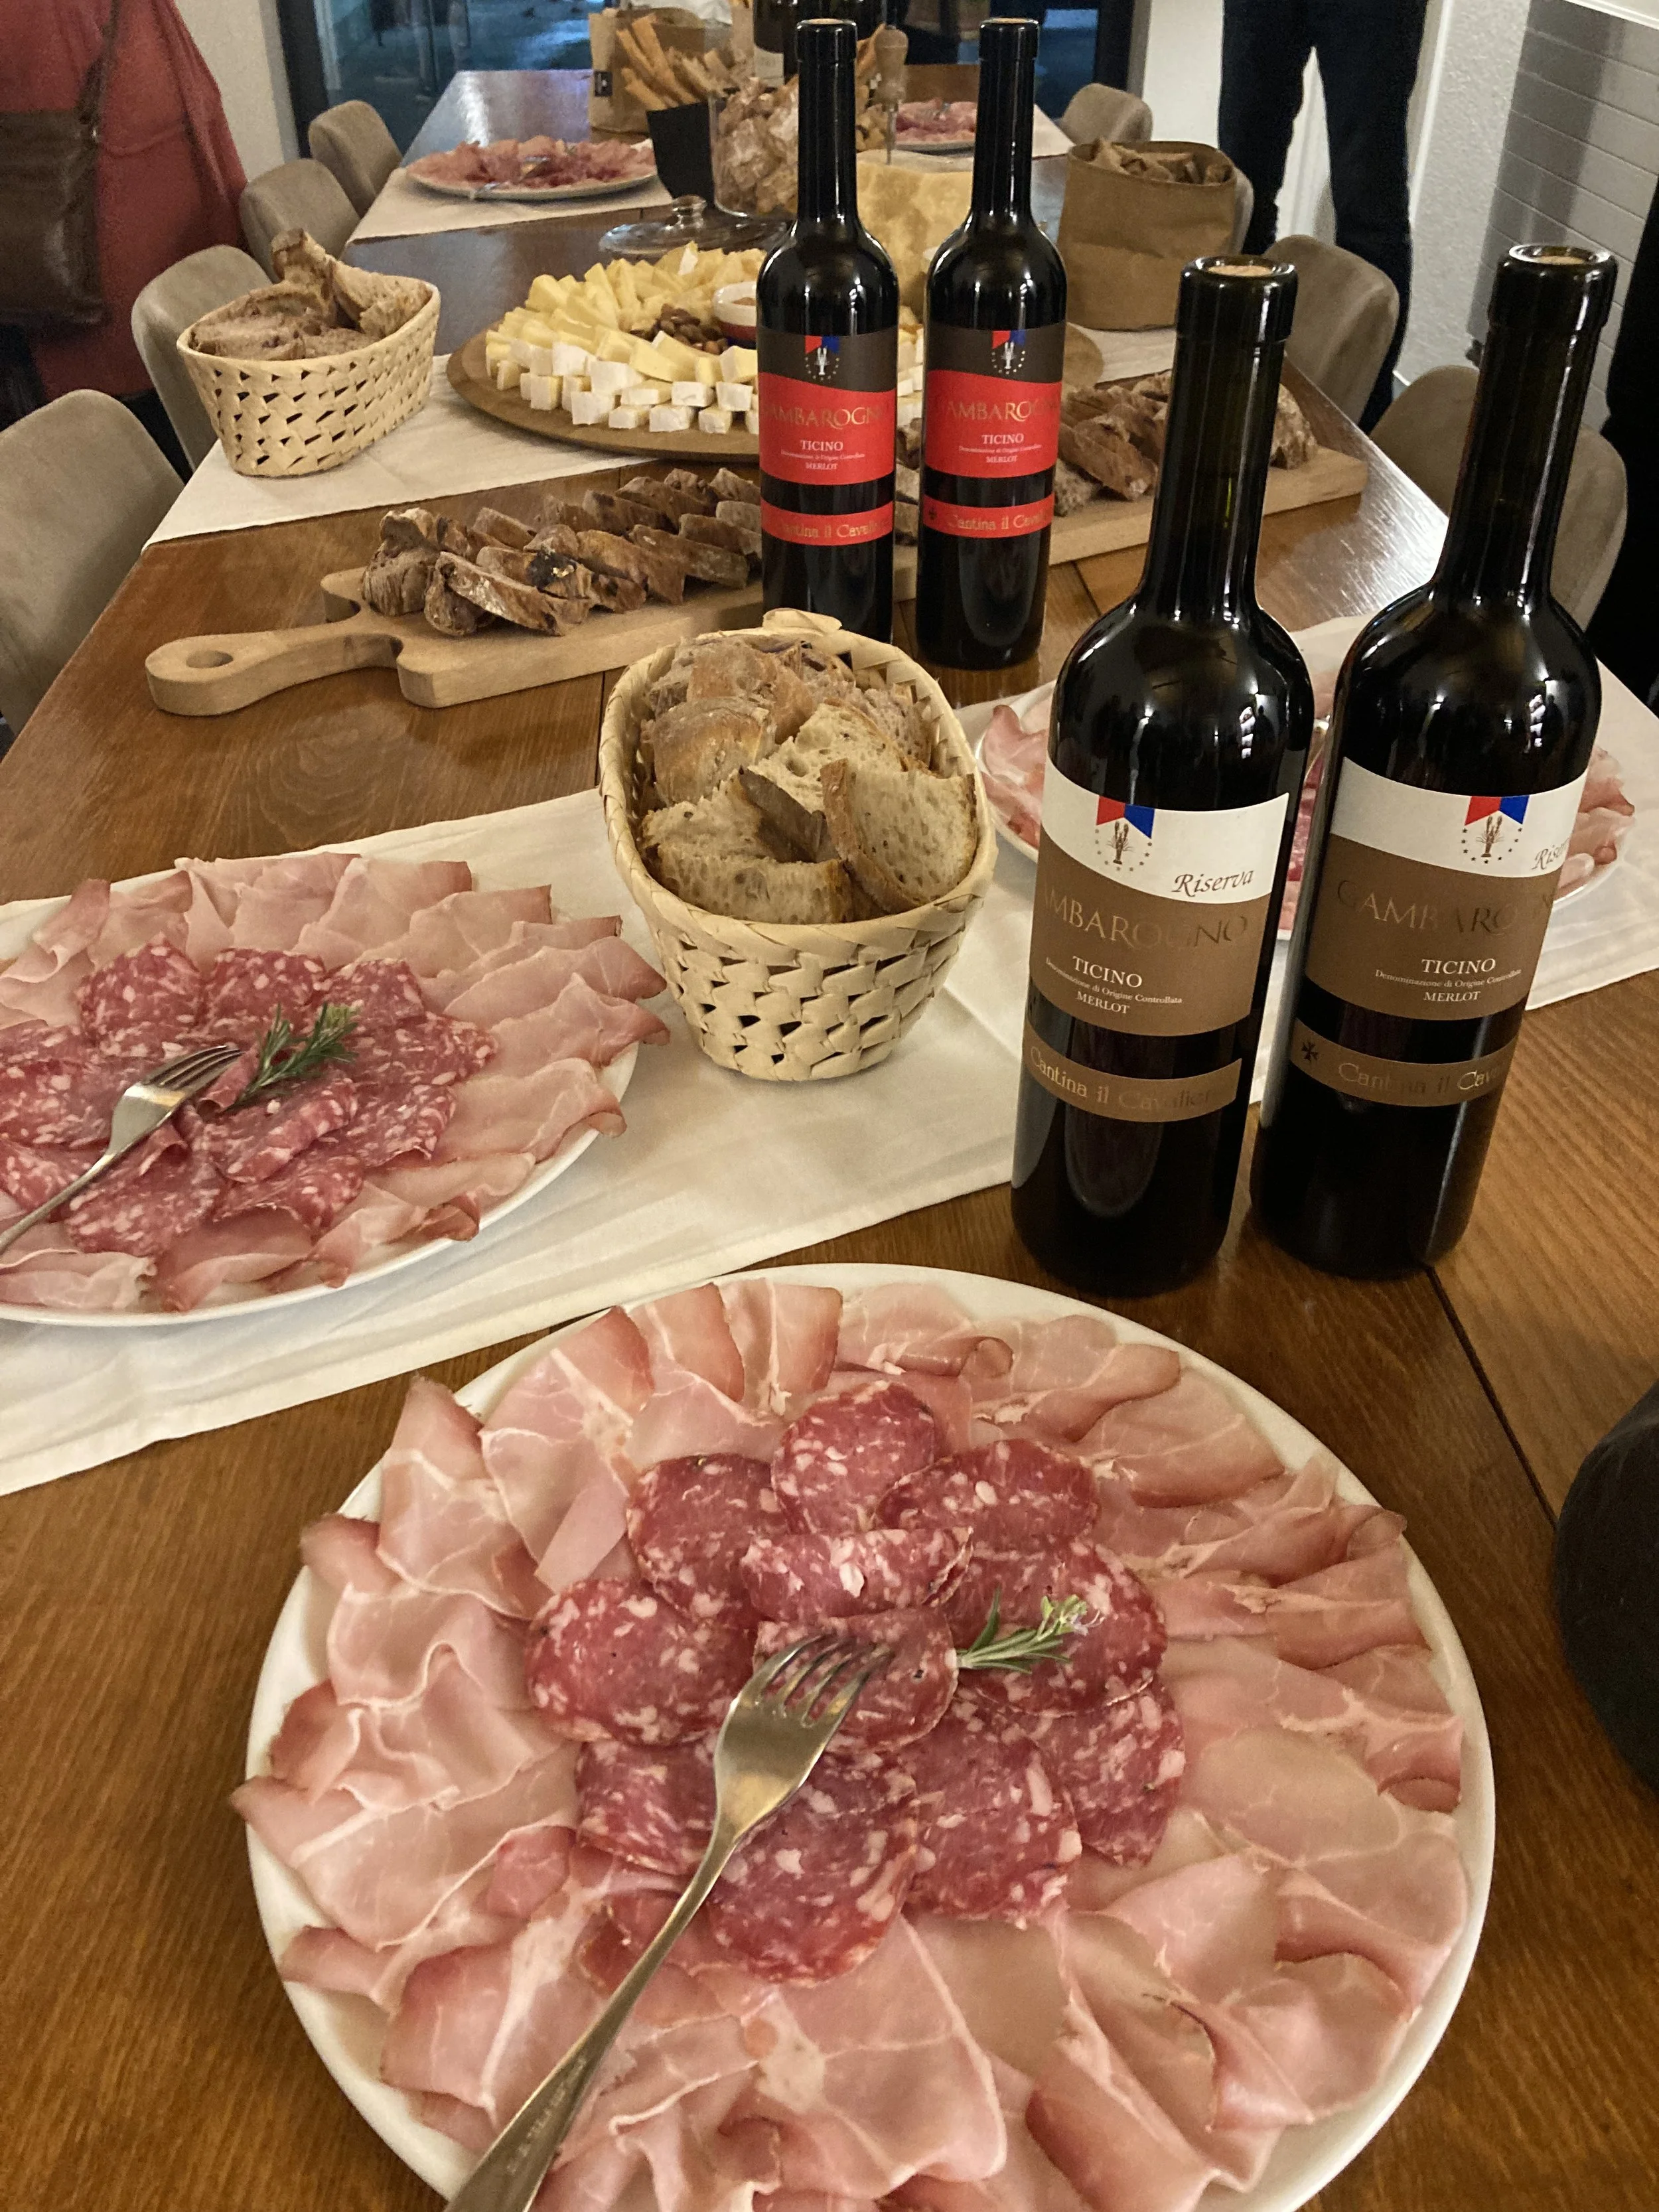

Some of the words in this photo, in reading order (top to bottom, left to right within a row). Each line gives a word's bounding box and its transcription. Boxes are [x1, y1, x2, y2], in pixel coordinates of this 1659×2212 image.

[800, 439, 843, 451] TICINO
[981, 433, 1025, 445] TICINO
[1001, 516, 1009, 530] il
[1172, 869, 1254, 897] Riserva
[1072, 956, 1143, 988] TICINO
[1421, 958, 1496, 974] TICINO
[1076, 991, 1130, 1014] MERLOT
[1102, 987, 1133, 1001] Origine
[1135, 994, 1183, 1004] Controllata
[1423, 991, 1481, 1002] MERLOT
[1030, 1046, 1088, 1098] Cantina
[1097, 1085, 1109, 1104] il
